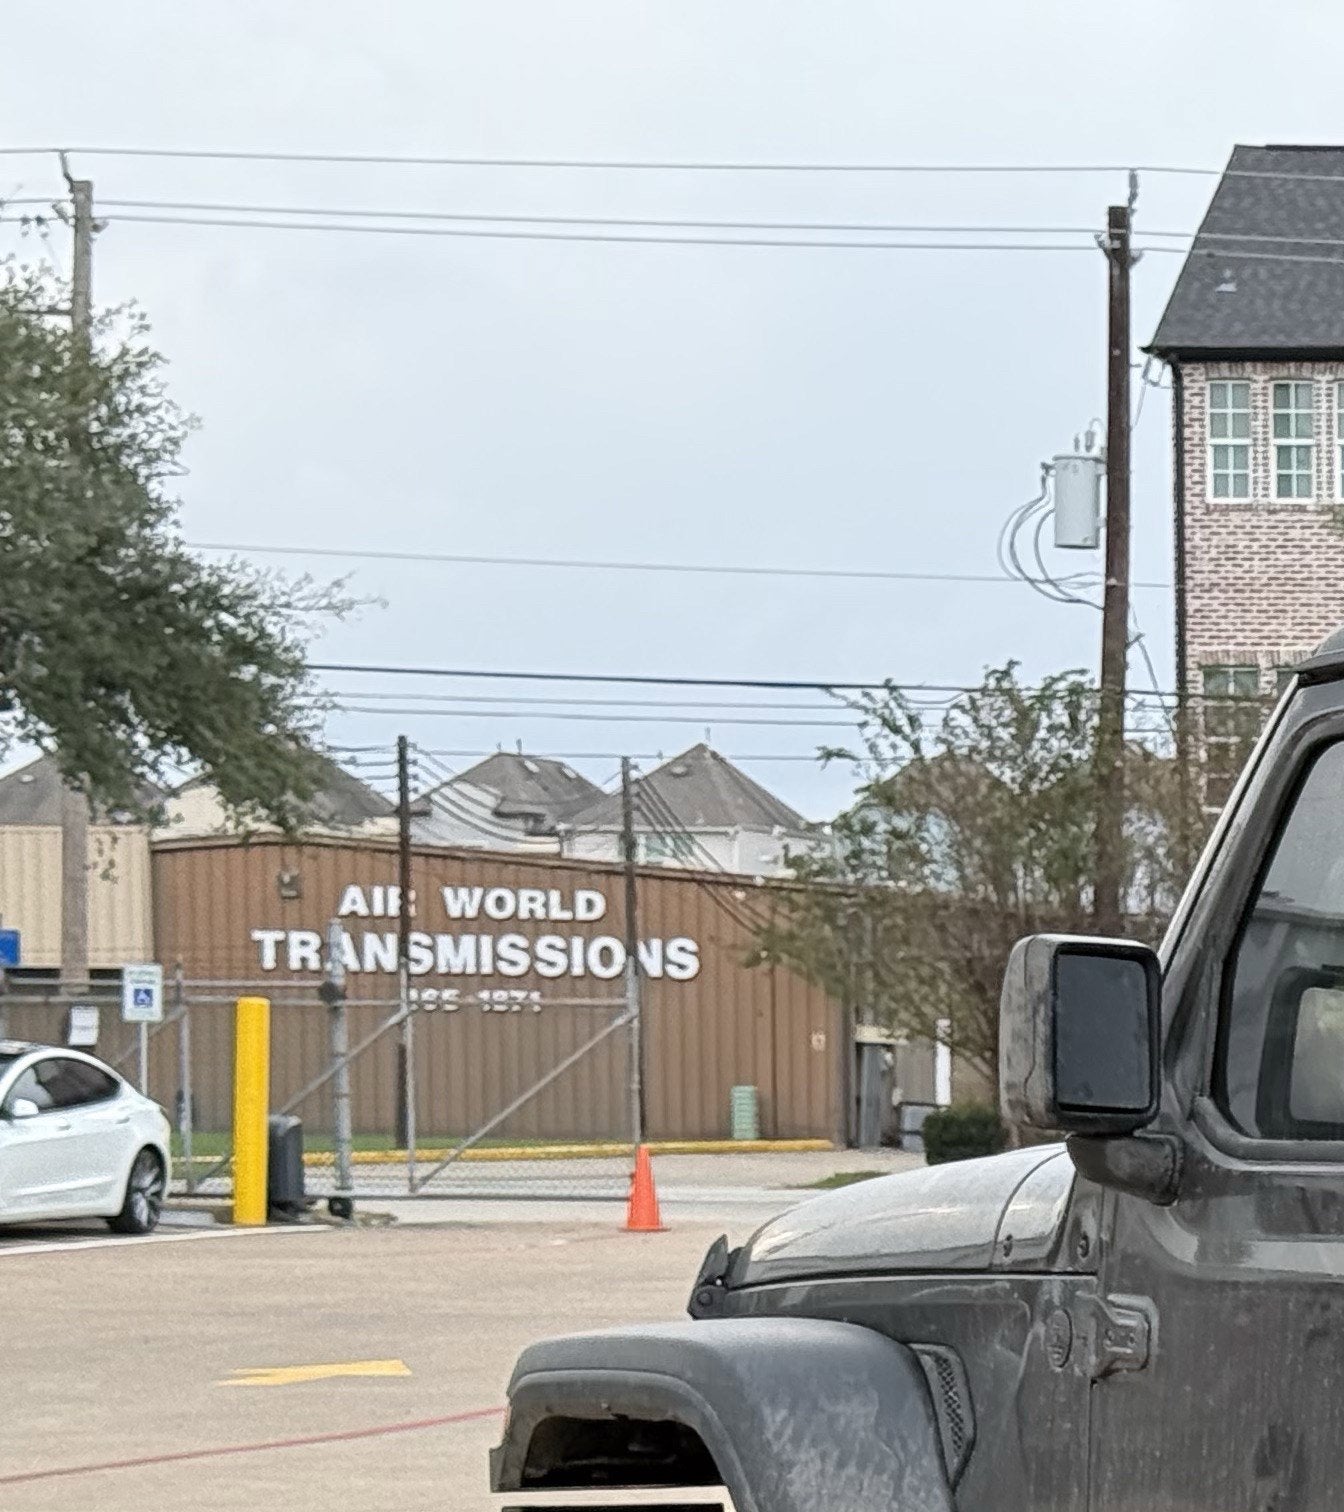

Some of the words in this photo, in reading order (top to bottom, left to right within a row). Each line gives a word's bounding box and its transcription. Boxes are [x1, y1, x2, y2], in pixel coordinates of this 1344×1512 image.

[338, 884, 416, 918] AIR
[441, 886, 607, 921] WORLD
[251, 928, 701, 981] TRANSMISSIONS
